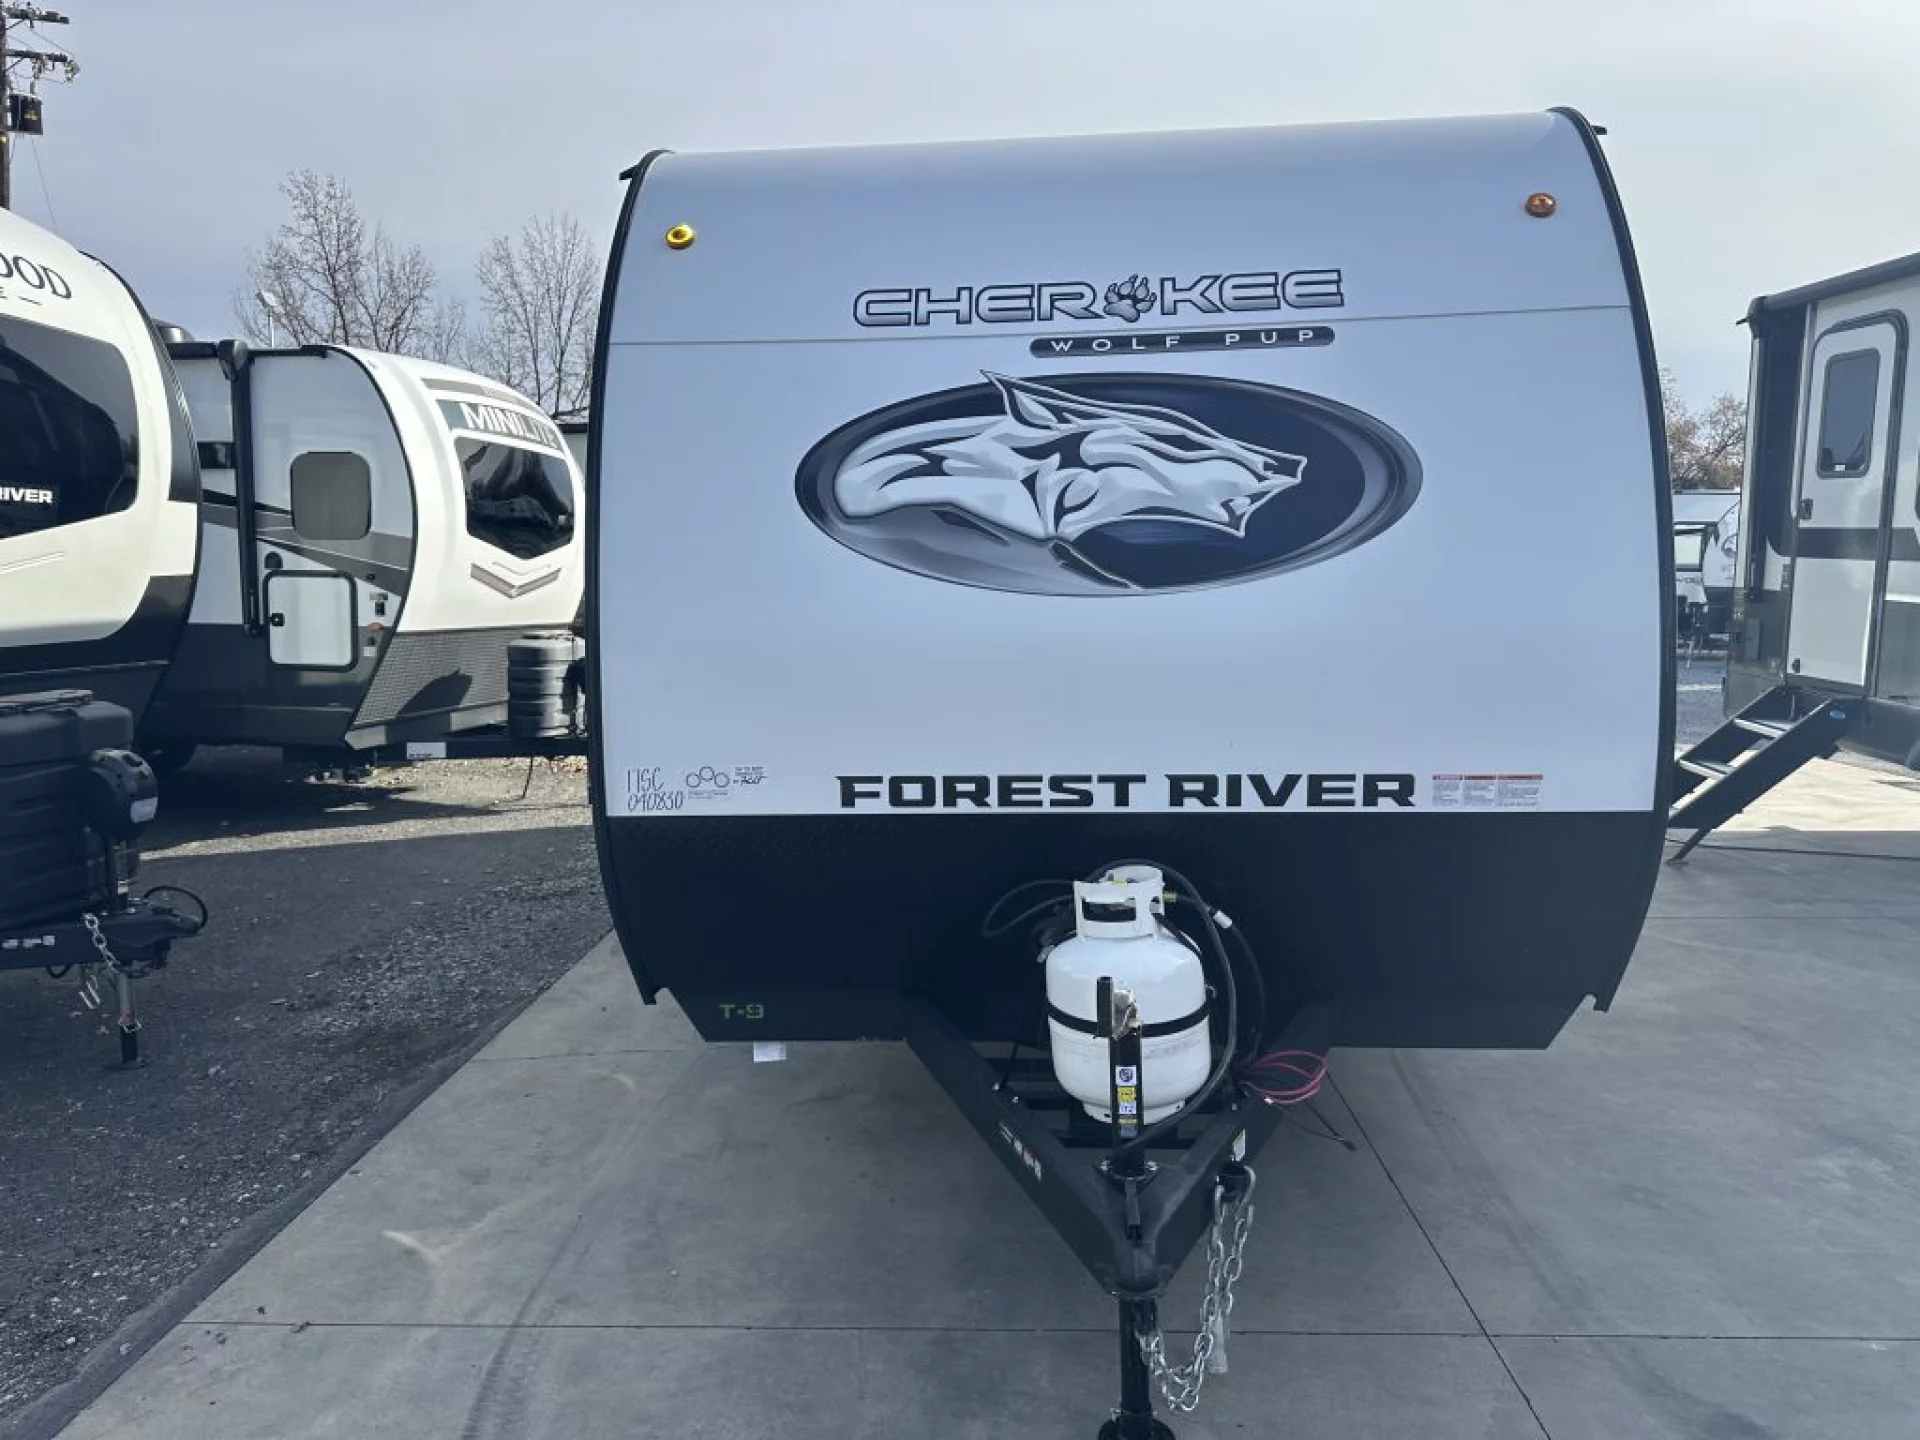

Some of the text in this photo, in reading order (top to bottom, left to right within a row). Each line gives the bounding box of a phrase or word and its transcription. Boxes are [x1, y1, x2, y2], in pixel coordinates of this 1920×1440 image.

[852, 269, 1345, 327] CHERKEE
[1049, 329, 1314, 352] WOLF PUP
[0, 487, 53, 503] IVER
[836, 774, 1147, 807] FOREST
[1164, 773, 1416, 807] RIVER
[718, 1004, 764, 1019] T-9
